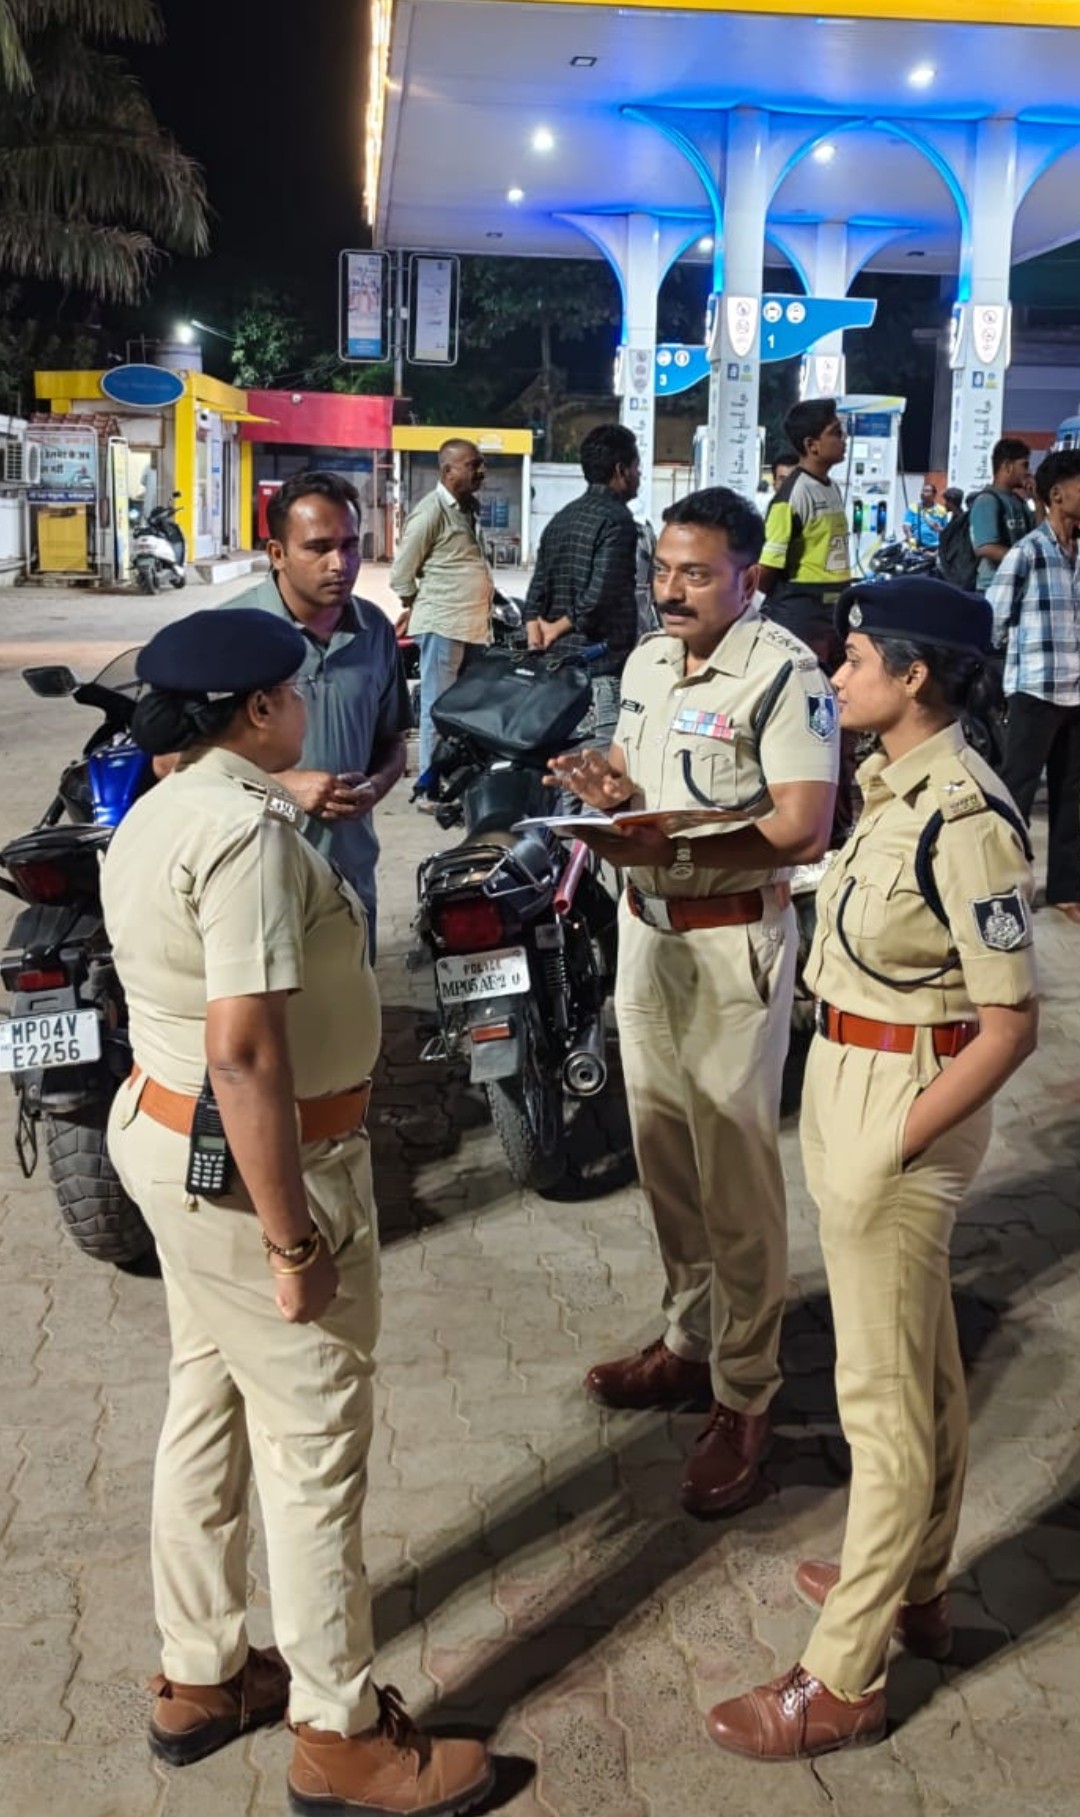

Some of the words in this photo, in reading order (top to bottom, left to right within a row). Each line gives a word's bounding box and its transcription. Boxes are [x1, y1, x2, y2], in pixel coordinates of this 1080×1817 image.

[767, 333, 775, 349] 1
[12, 1014, 77, 1044] MP04V
[13, 1039, 80, 1068] E2256
